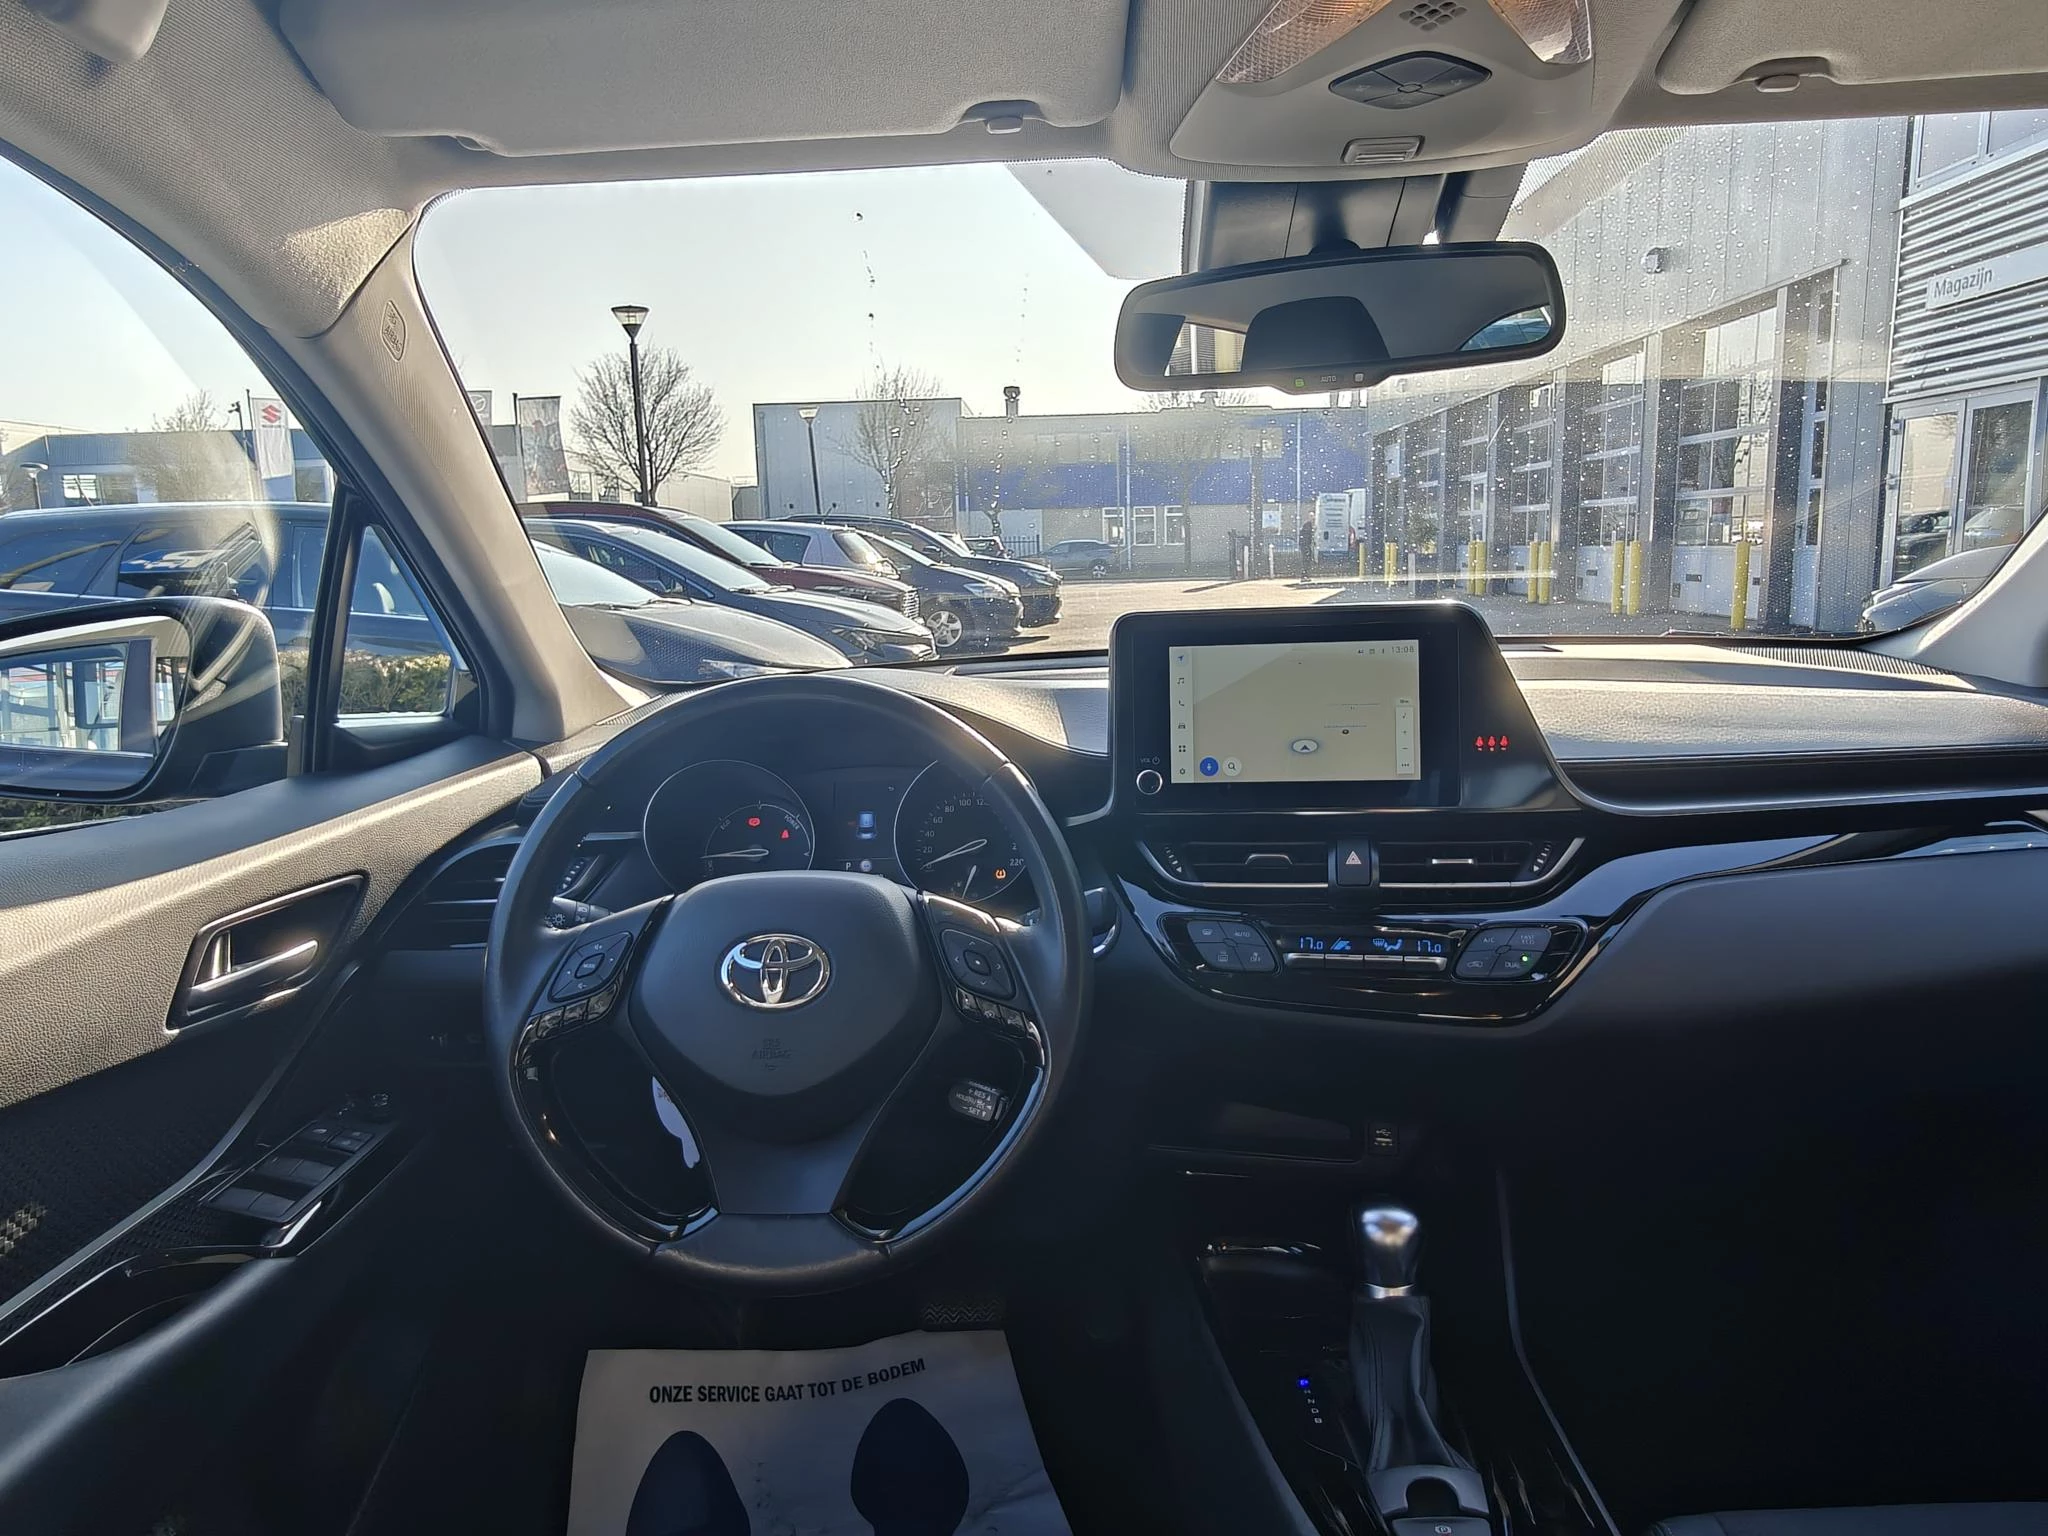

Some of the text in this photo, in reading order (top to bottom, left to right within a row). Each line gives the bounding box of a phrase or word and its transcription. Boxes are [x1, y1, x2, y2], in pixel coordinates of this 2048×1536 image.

[1933, 267, 1993, 298] Magazijn
[959, 799, 972, 807] 100
[933, 816, 943, 824] 60
[1300, 937, 1323, 950] 17.0
[1417, 940, 1441, 953] 17.0
[1504, 961, 1521, 969] DUAL
[650, 1357, 926, 1404] ONZE SERVICE GAAT TOT DE BODEM
